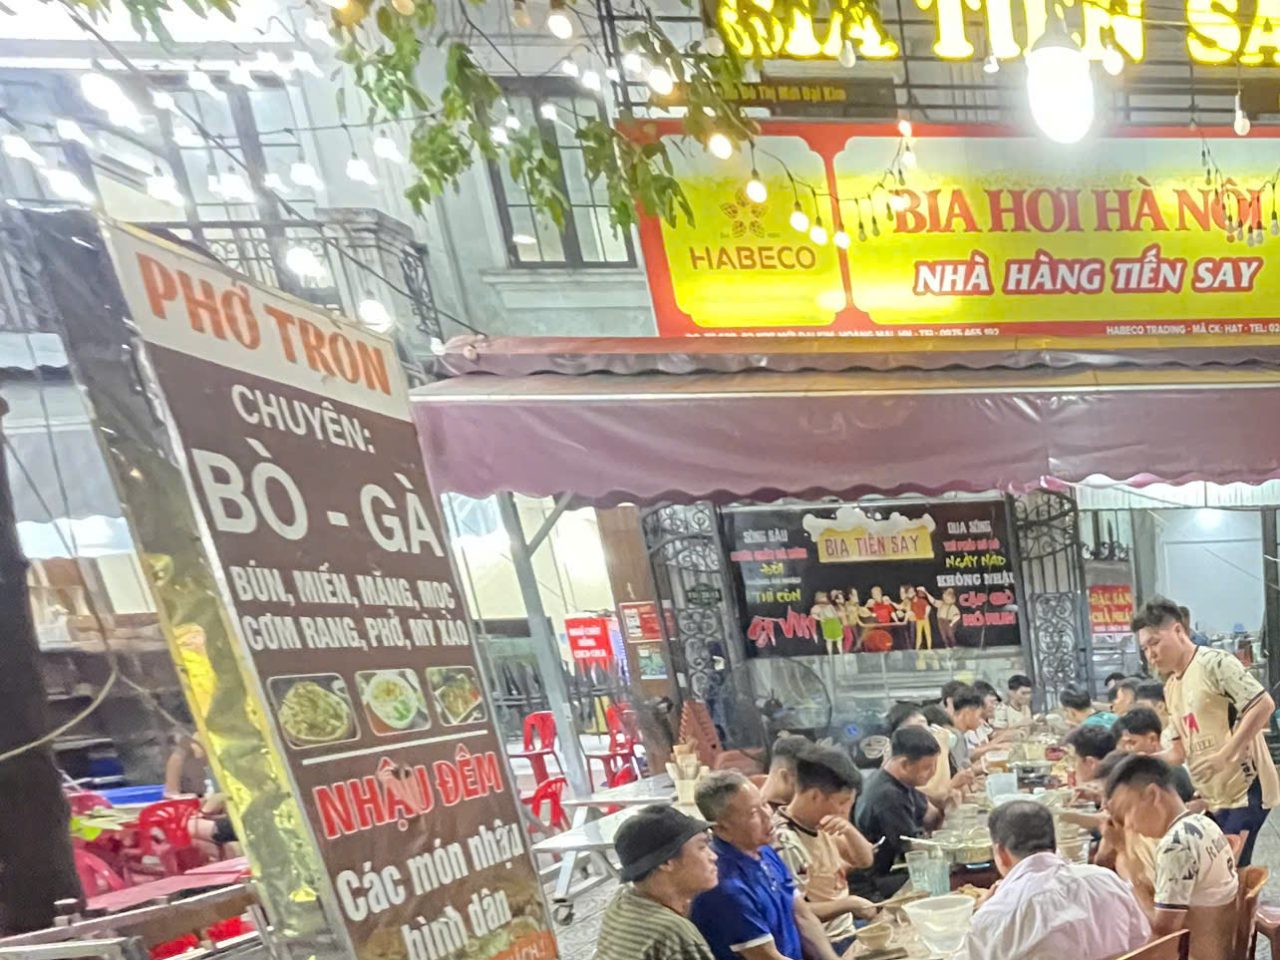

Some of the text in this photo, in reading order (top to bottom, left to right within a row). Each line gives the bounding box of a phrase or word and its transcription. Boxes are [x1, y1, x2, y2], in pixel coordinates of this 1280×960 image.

[893, 188, 978, 232] BIA
[1093, 175, 1169, 232] HÀ
[690, 246, 816, 270] HABECO
[915, 252, 991, 293] NHÀ
[1005, 251, 1103, 292] HÀNG
[1193, 261, 1260, 290] SAY
[1106, 325, 1143, 335] HABECO
[1146, 324, 1186, 335] TRADING
[231, 384, 376, 454] CHUYÊN:
[191, 437, 308, 541] BÒ
[360, 472, 445, 558] GÀ
[824, 537, 850, 557] BIA
[890, 534, 919, 554] SAY
[945, 552, 978, 568] NGÀY
[229, 560, 296, 608] BÚN,
[936, 572, 982, 587] KHÔNG
[242, 613, 302, 651] CƠM
[300, 616, 368, 651] RANG,
[312, 743, 504, 840] NHẬU ĐÊM
[336, 818, 525, 922] Các món nhậu
[467, 887, 513, 938] dân
